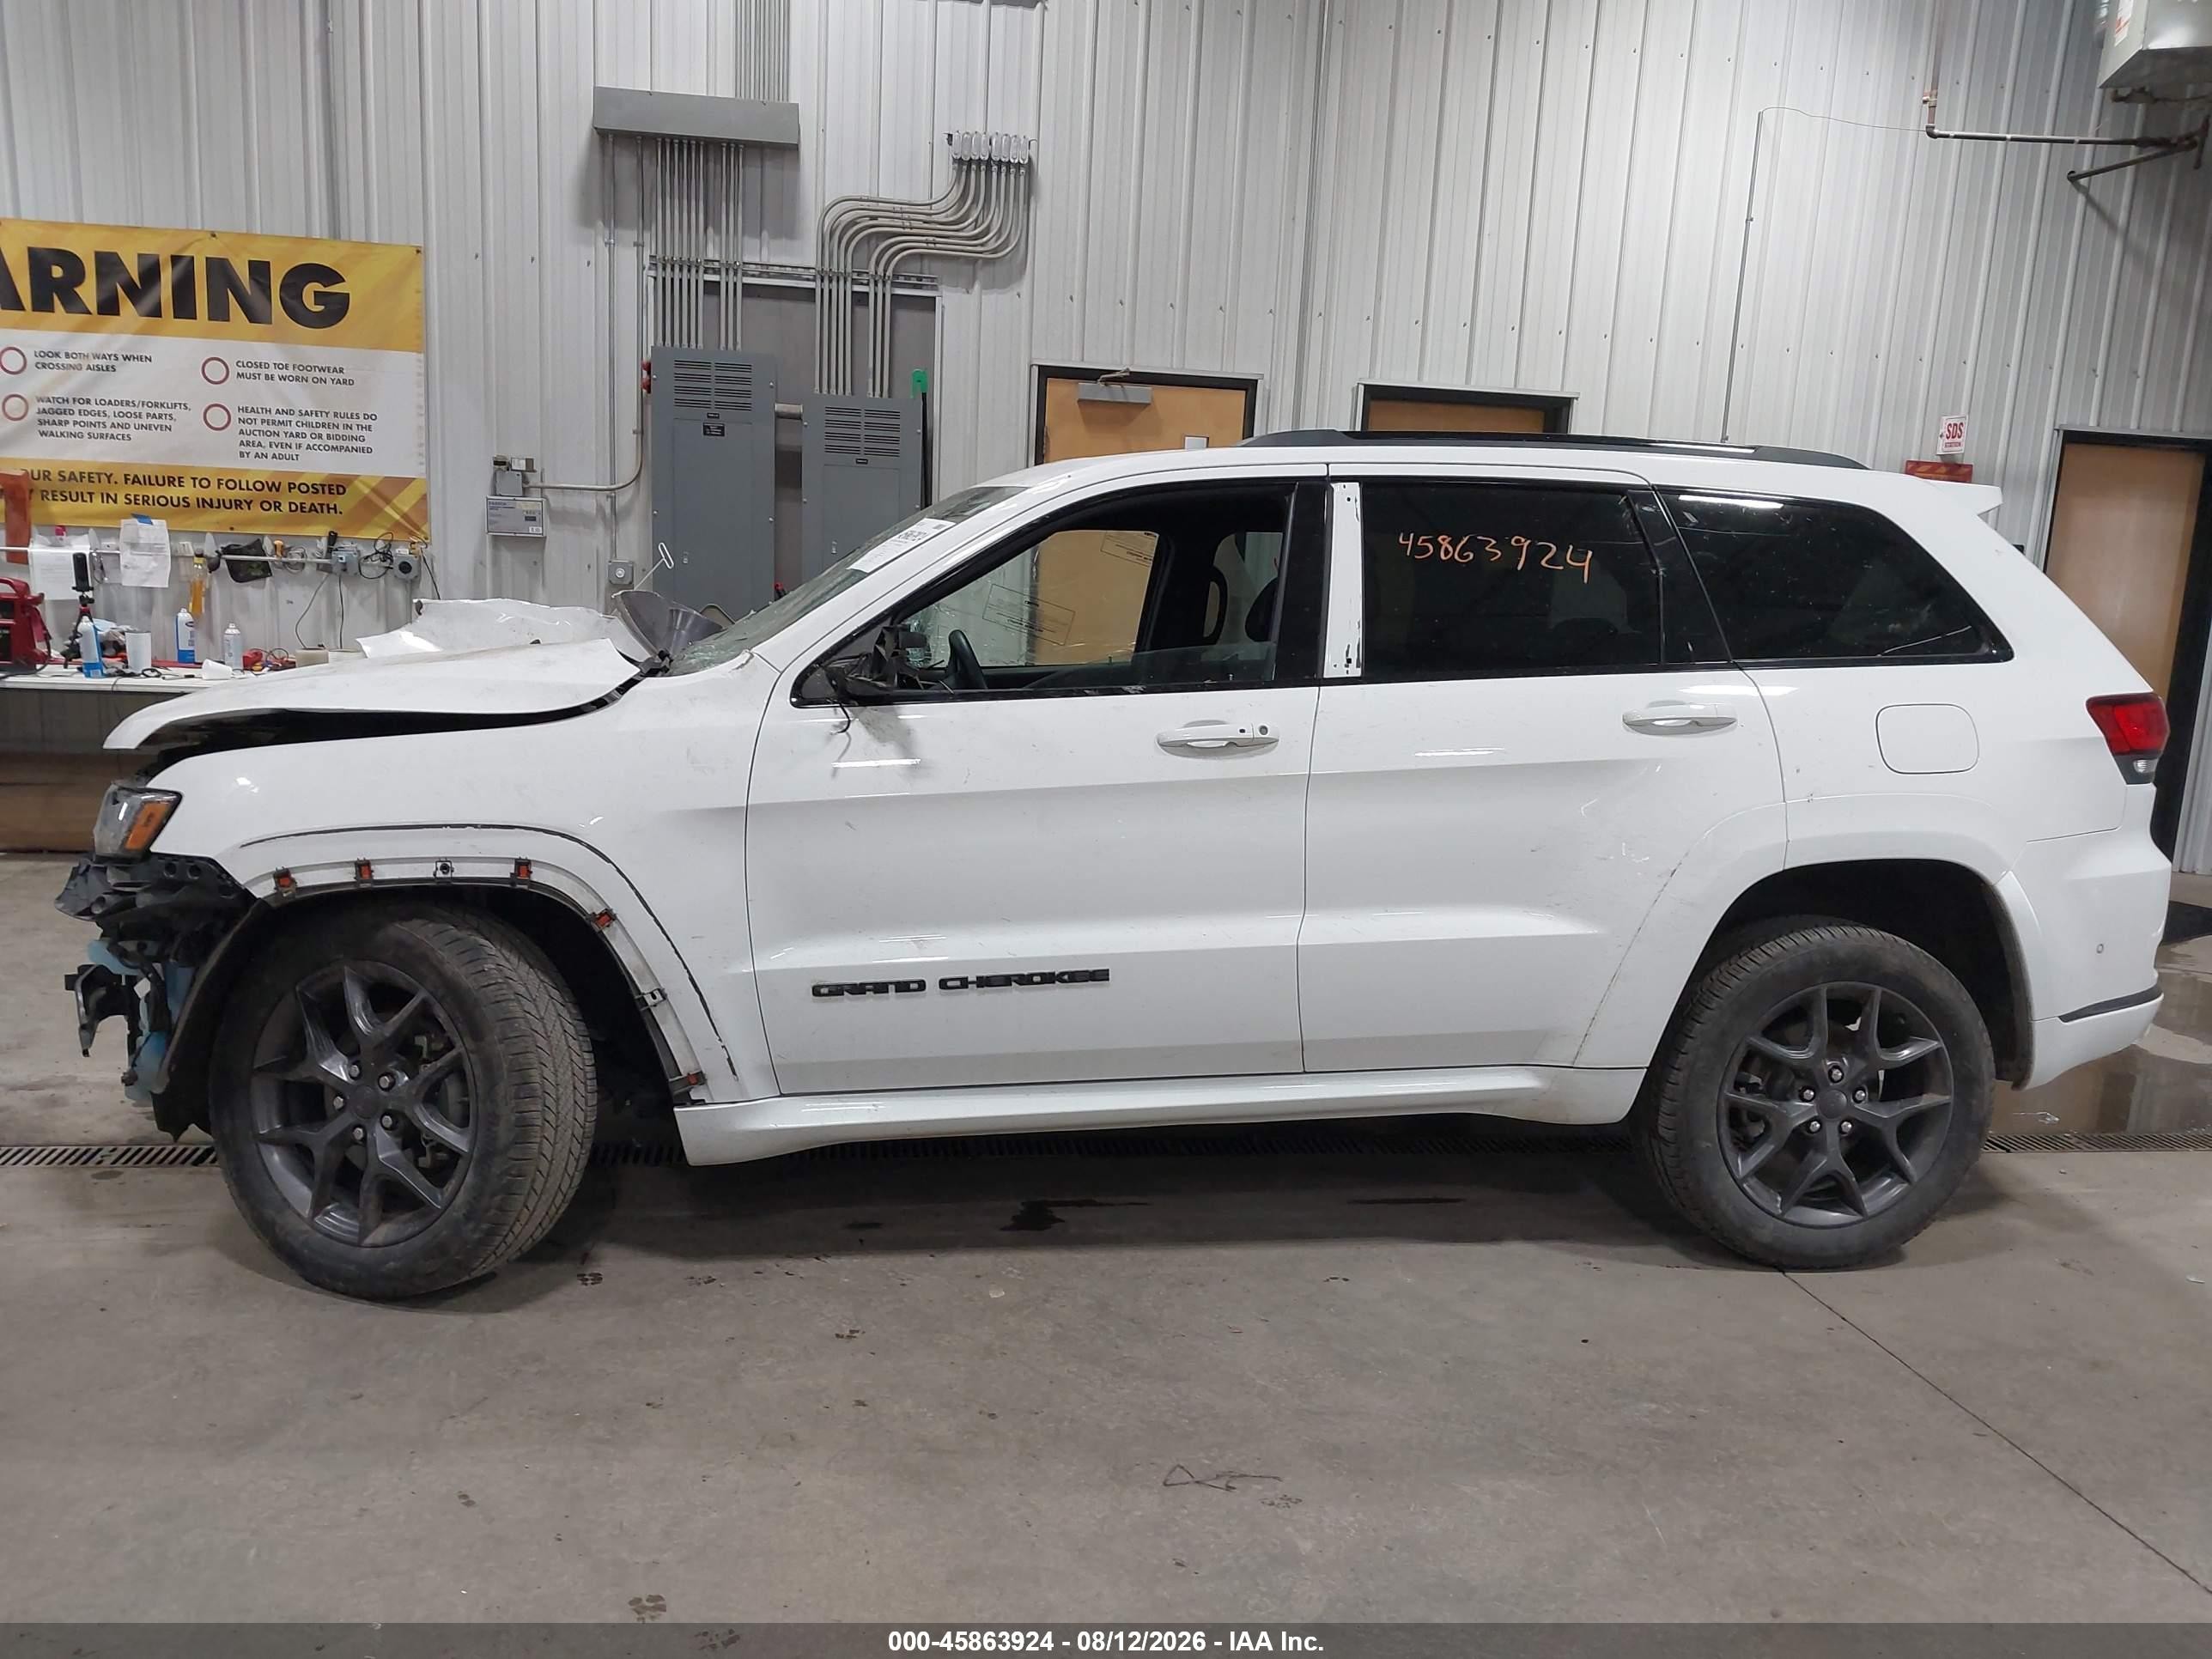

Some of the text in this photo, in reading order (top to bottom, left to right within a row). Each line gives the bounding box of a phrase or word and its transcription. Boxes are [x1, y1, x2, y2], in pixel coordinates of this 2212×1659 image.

[34, 350, 61, 359] LOOK
[92, 353, 118, 362] WAYS
[121, 354, 152, 362] WHEN
[34, 362, 83, 371] CROSSING
[236, 360, 344, 374] CLOSED TOE FOOTWEAR
[236, 372, 261, 380] MUST
[278, 374, 308, 383] WORN
[312, 376, 327, 385] ON
[330, 377, 355, 386] YARD
[36, 396, 69, 404] WATCH
[94, 398, 191, 410] LOADERS/FORKLIFTS,
[78, 409, 110, 418] EDGES,
[113, 410, 143, 419] LOOSE
[237, 406, 271, 416] HEALTH
[275, 408, 295, 416] AND
[298, 409, 330, 418] SAFETY
[333, 411, 360, 420] RULES
[37, 418, 173, 432] SHARP POINTS AND UNEVEN
[238, 417, 258, 426] NOT
[260, 418, 293, 428] PERMIT
[295, 420, 340, 430] CHILDREN
[356, 423, 373, 432] THE
[1945, 422, 1964, 440] SDS
[38, 430, 132, 441] WALKING SURFACES
[239, 428, 366, 442] AUCTION YARD OR BIDDING
[306, 444, 373, 454] ACCOMPANIED
[271, 453, 300, 461] ADULT
[58, 471, 118, 484] SAFETY.
[124, 474, 185, 488] FAILURE
[191, 477, 211, 489] TO
[217, 478, 282, 492] FOLLOW
[288, 482, 347, 495] POSTED
[40, 489, 94, 503] RESULT
[100, 492, 118, 504] IN
[124, 494, 191, 508] SERIOUS
[197, 497, 253, 511] INJURY
[260, 500, 283, 513] OR
[289, 501, 343, 514] DEATH.
[1399, 532, 1593, 585] 45863924
[811, 969, 1110, 998] GRAND CHEROKEE
